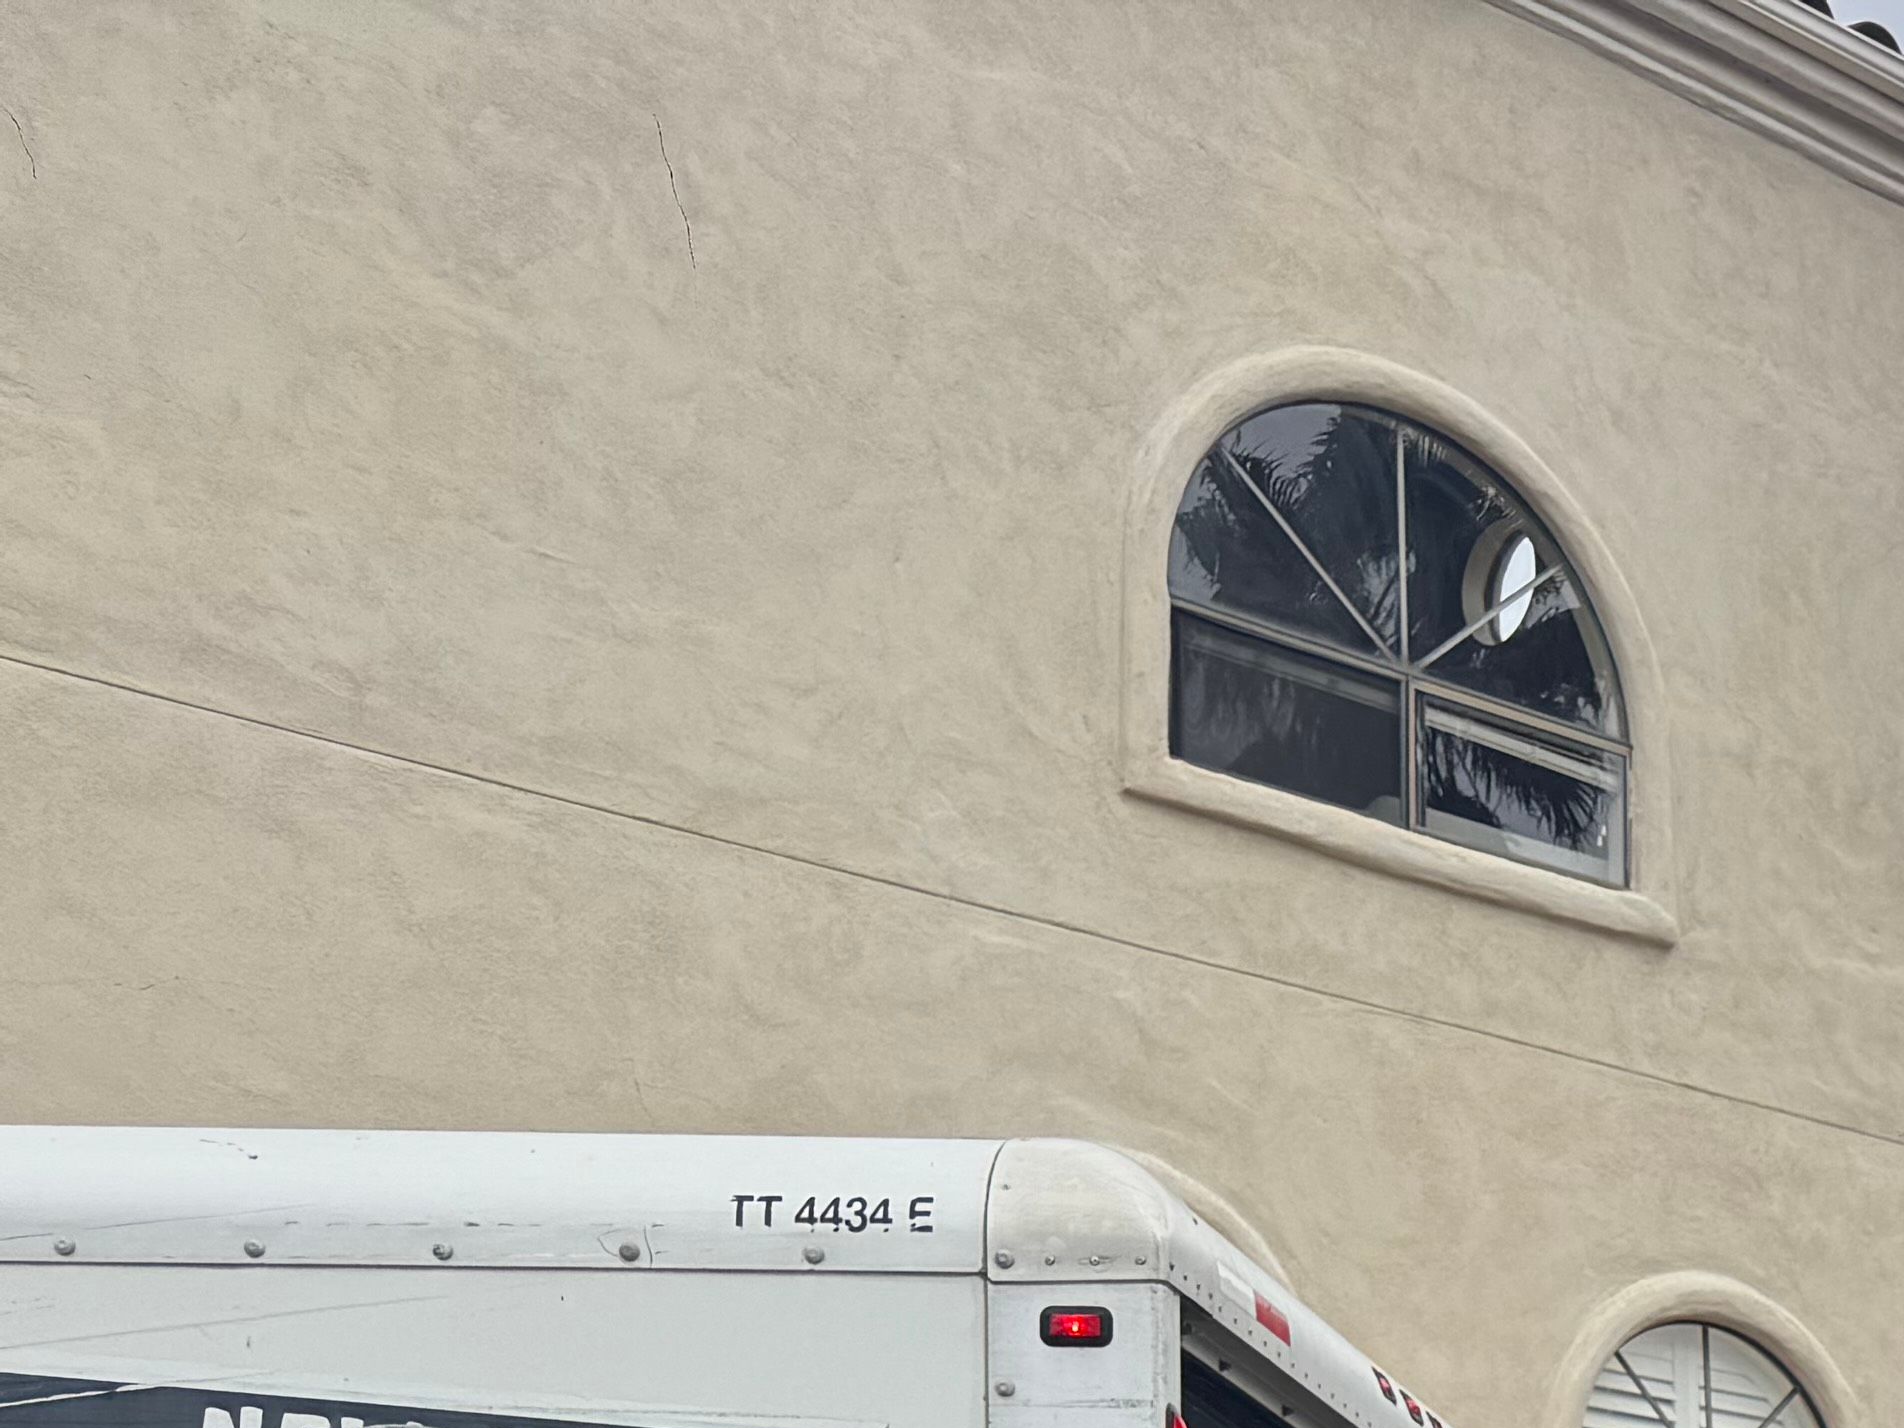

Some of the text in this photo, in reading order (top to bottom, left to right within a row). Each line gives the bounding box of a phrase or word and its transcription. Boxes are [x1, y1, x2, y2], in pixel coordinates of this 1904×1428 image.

[730, 1195, 934, 1233] TT 4434 E
